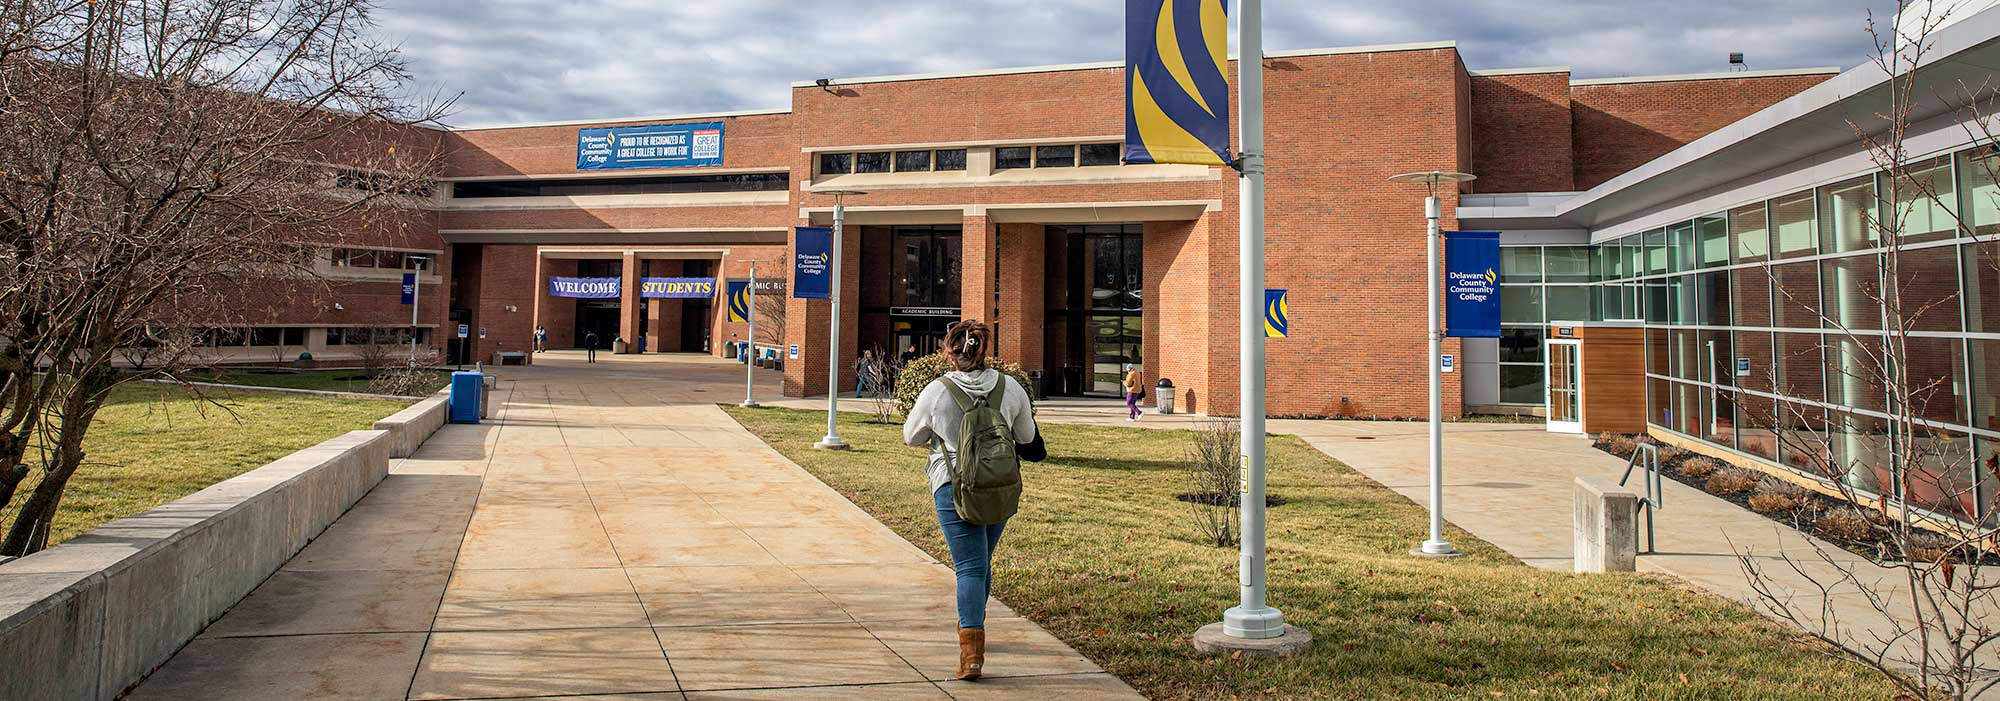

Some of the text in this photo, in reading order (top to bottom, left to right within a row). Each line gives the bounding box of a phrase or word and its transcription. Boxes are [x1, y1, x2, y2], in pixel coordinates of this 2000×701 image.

[620, 135, 686, 147] PROUD TO BE RECOGNIZED AS
[697, 136, 718, 144] GREAT
[581, 149, 612, 157] Community
[616, 149, 621, 158] A
[621, 148, 636, 158] GREAT
[636, 147, 656, 158] COLLEGE
[656, 147, 664, 157] TO
[664, 146, 677, 156] WORK
[553, 281, 617, 294] WELCOME
[1459, 279, 1486, 287] County
[641, 282, 712, 294] STUDENTS
[1450, 286, 1494, 294] Community
[1460, 293, 1488, 302] College
